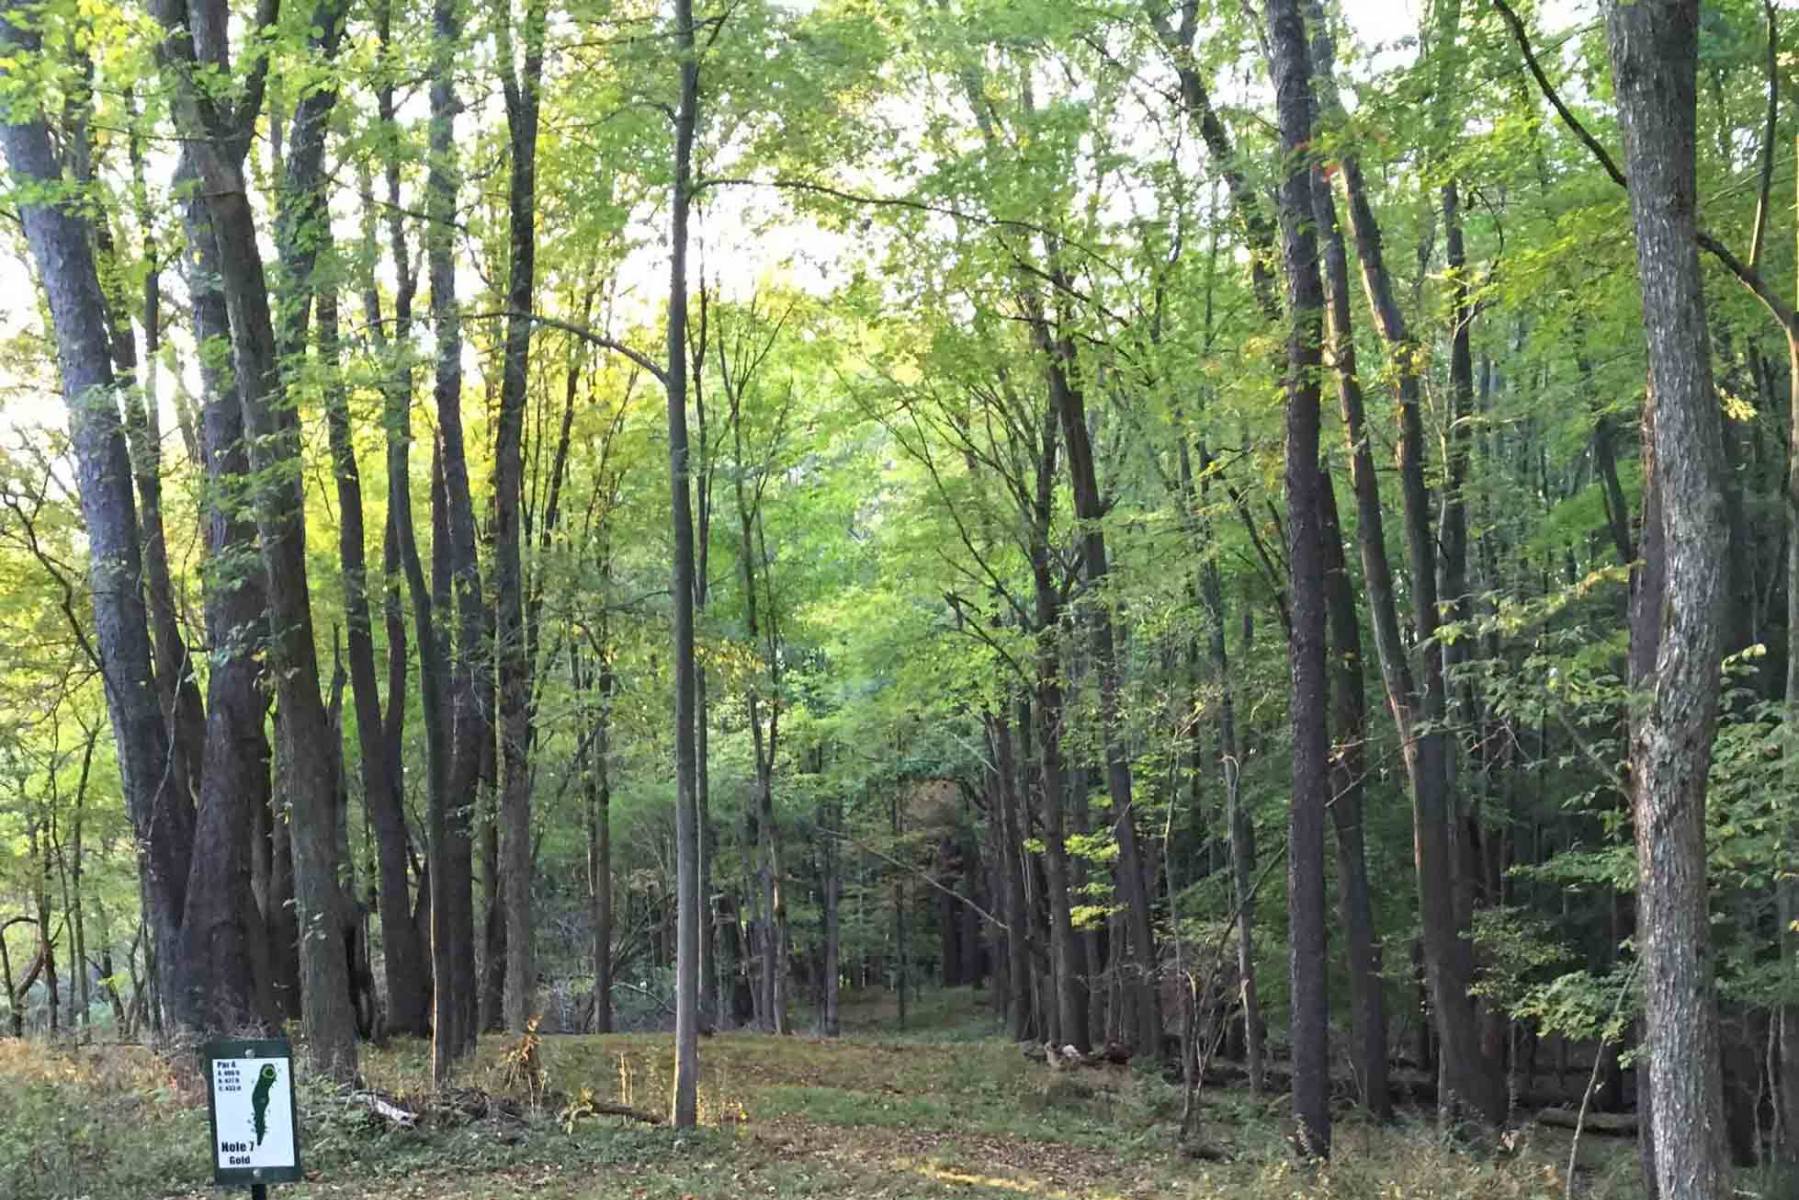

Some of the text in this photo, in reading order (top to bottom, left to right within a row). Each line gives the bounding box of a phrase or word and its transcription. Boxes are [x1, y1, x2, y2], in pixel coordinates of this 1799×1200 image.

[221, 1141, 254, 1152] Hole 7
[229, 1155, 250, 1165] Gold
